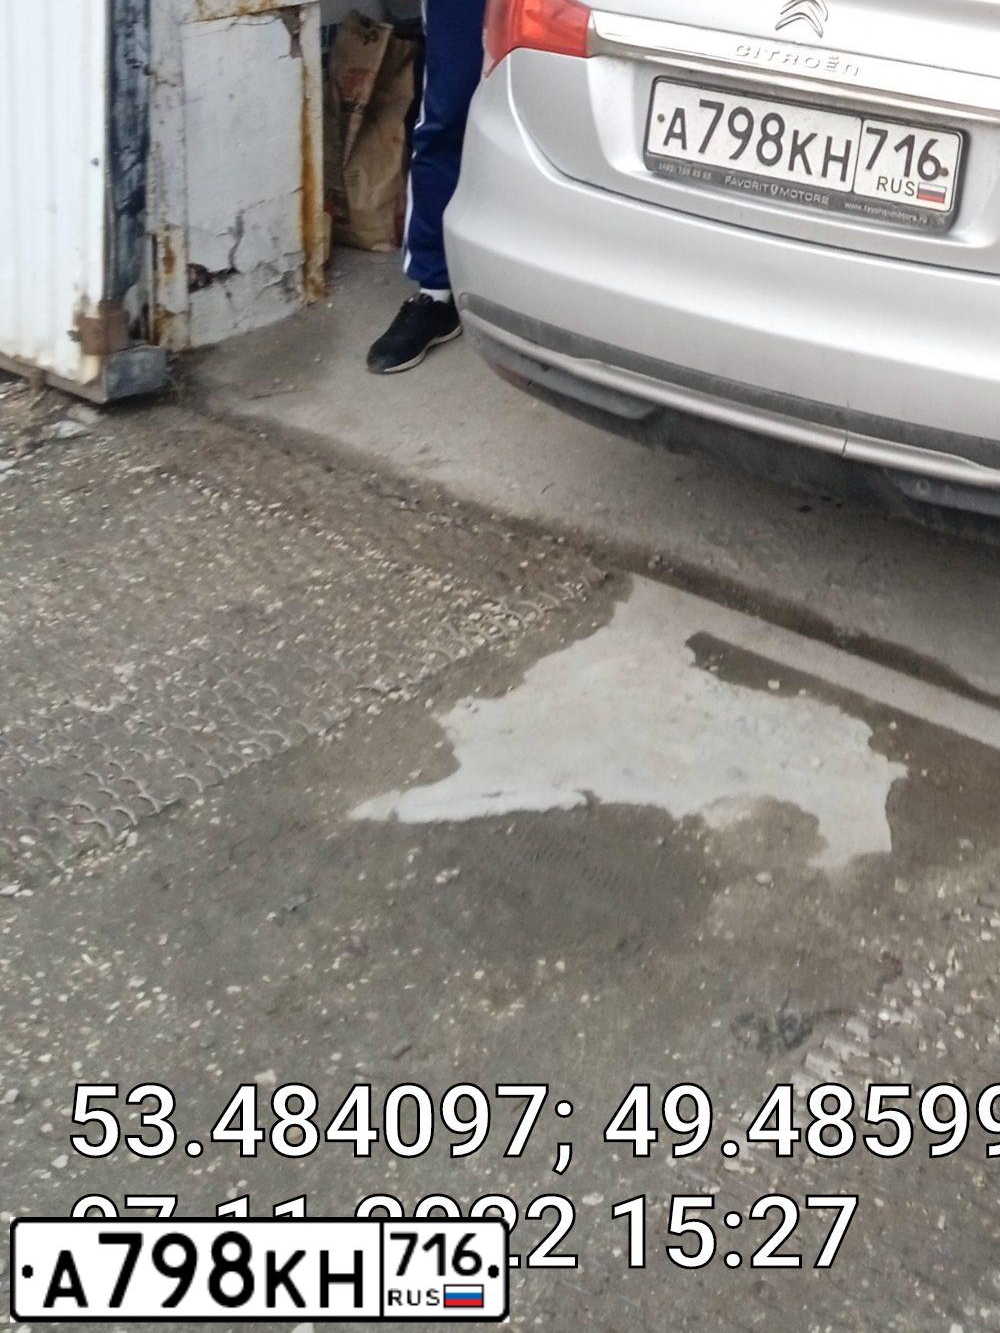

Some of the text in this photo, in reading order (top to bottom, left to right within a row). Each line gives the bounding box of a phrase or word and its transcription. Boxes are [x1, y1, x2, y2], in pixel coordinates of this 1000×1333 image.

[865, 127, 942, 181] 716
[724, 174, 772, 193] FAVORIT
[876, 175, 916, 197] RUS
